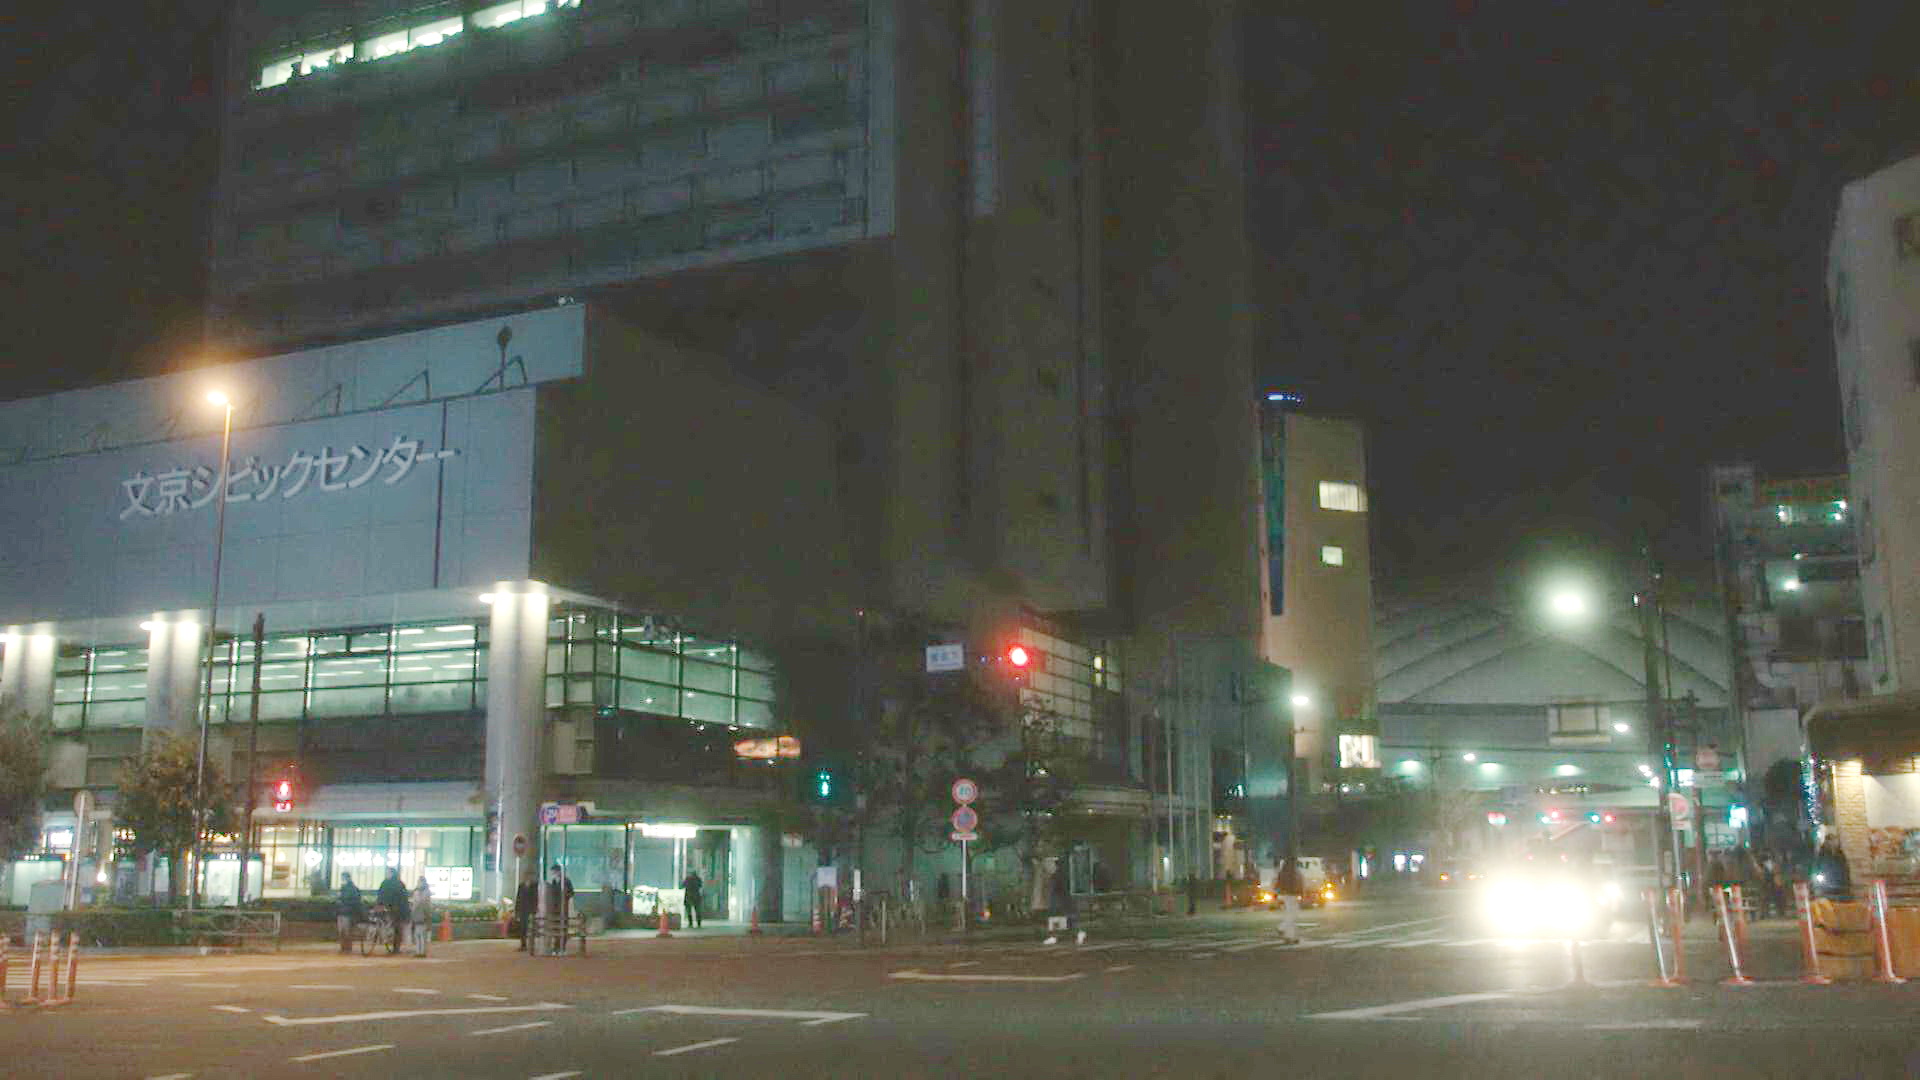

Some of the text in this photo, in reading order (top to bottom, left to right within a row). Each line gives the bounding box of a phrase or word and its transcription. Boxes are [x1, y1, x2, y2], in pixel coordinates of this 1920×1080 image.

[119, 436, 458, 520] 文京シビックセンター
